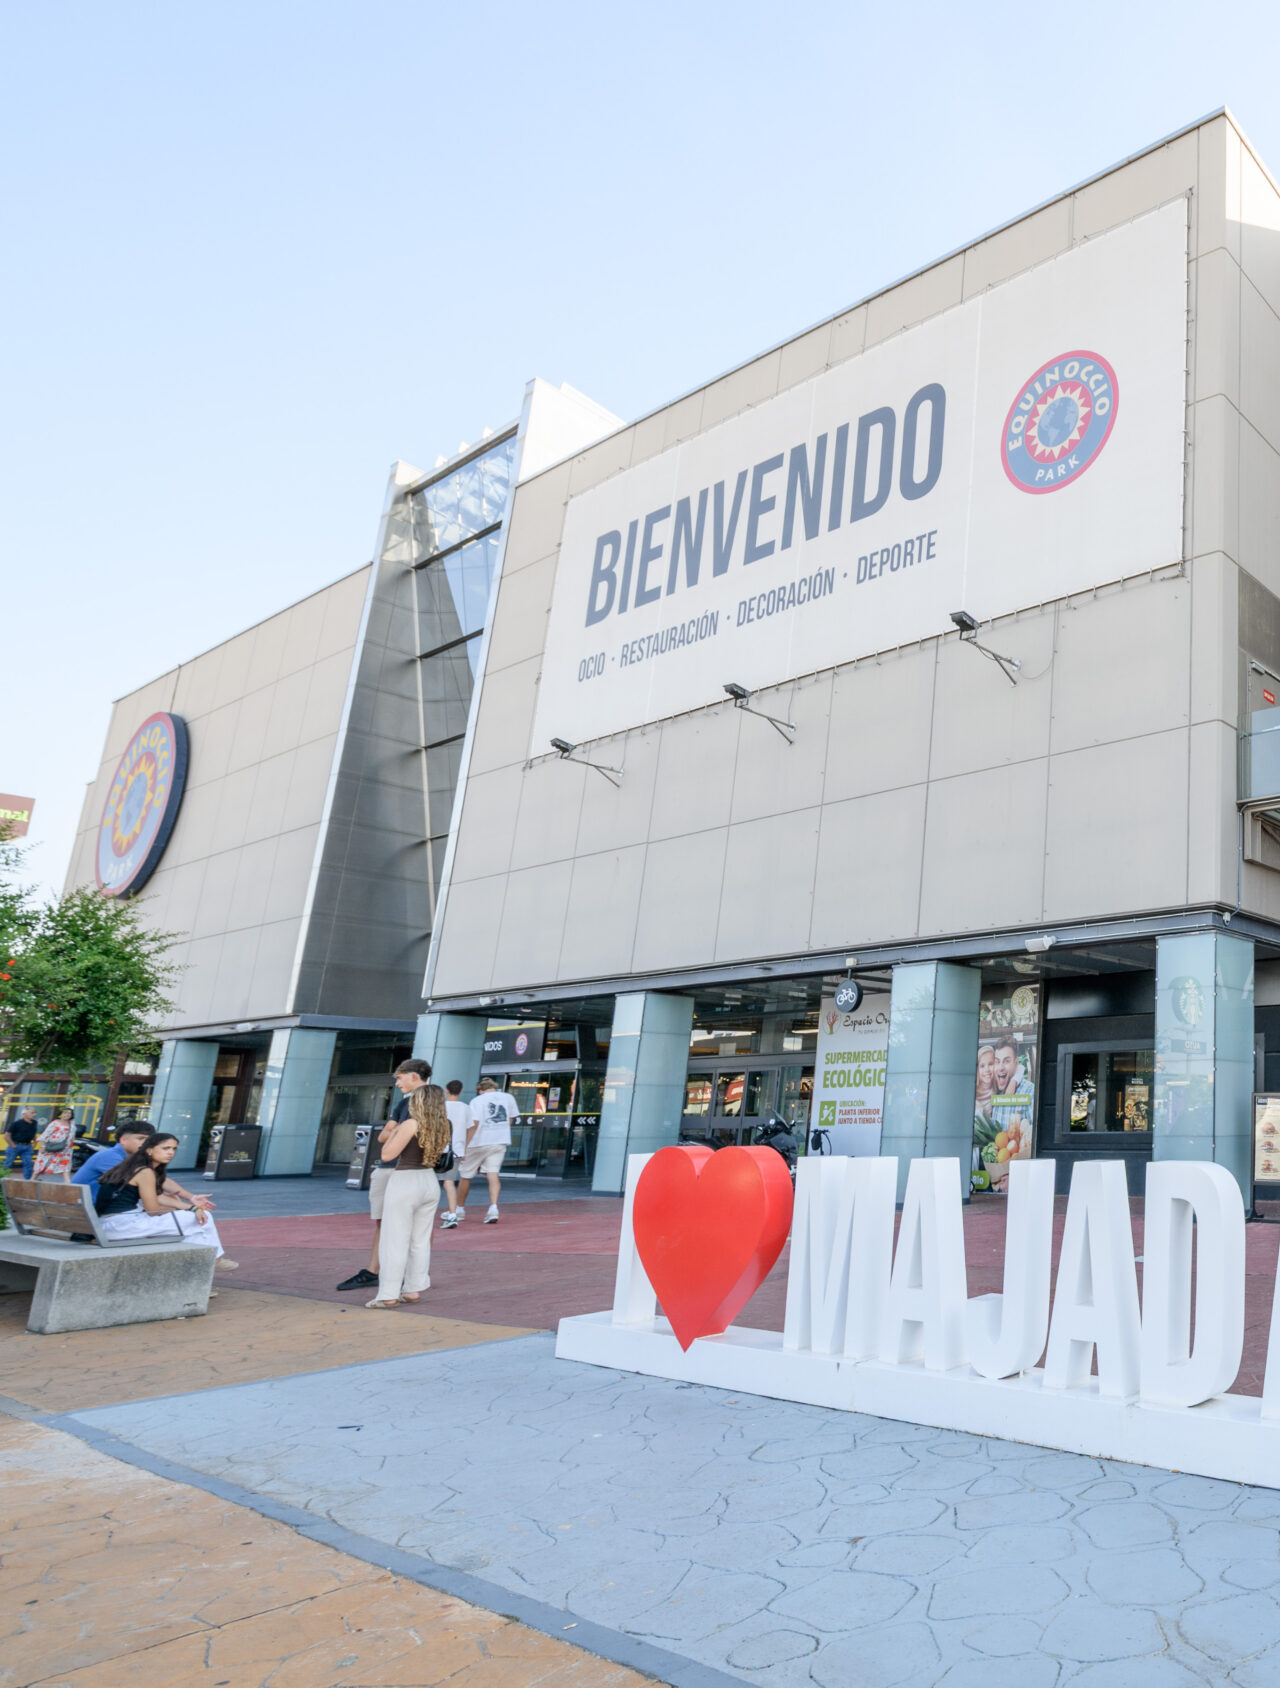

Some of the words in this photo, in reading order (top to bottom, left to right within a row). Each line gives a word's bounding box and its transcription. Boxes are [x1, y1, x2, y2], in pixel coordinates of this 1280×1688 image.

[1008, 358, 1110, 452] EQUINOCCIO
[1034, 453, 1080, 482] PARK
[584, 382, 946, 628] BIENVENIDO
[577, 652, 605, 682] OCIO
[619, 609, 718, 668] RESTAURACIÓN
[736, 566, 835, 628] DECORACIÓN
[856, 529, 938, 585] DEPORTE
[843, 1014, 873, 1032] Espacio
[857, 1108, 880, 1116] INFERIOR
